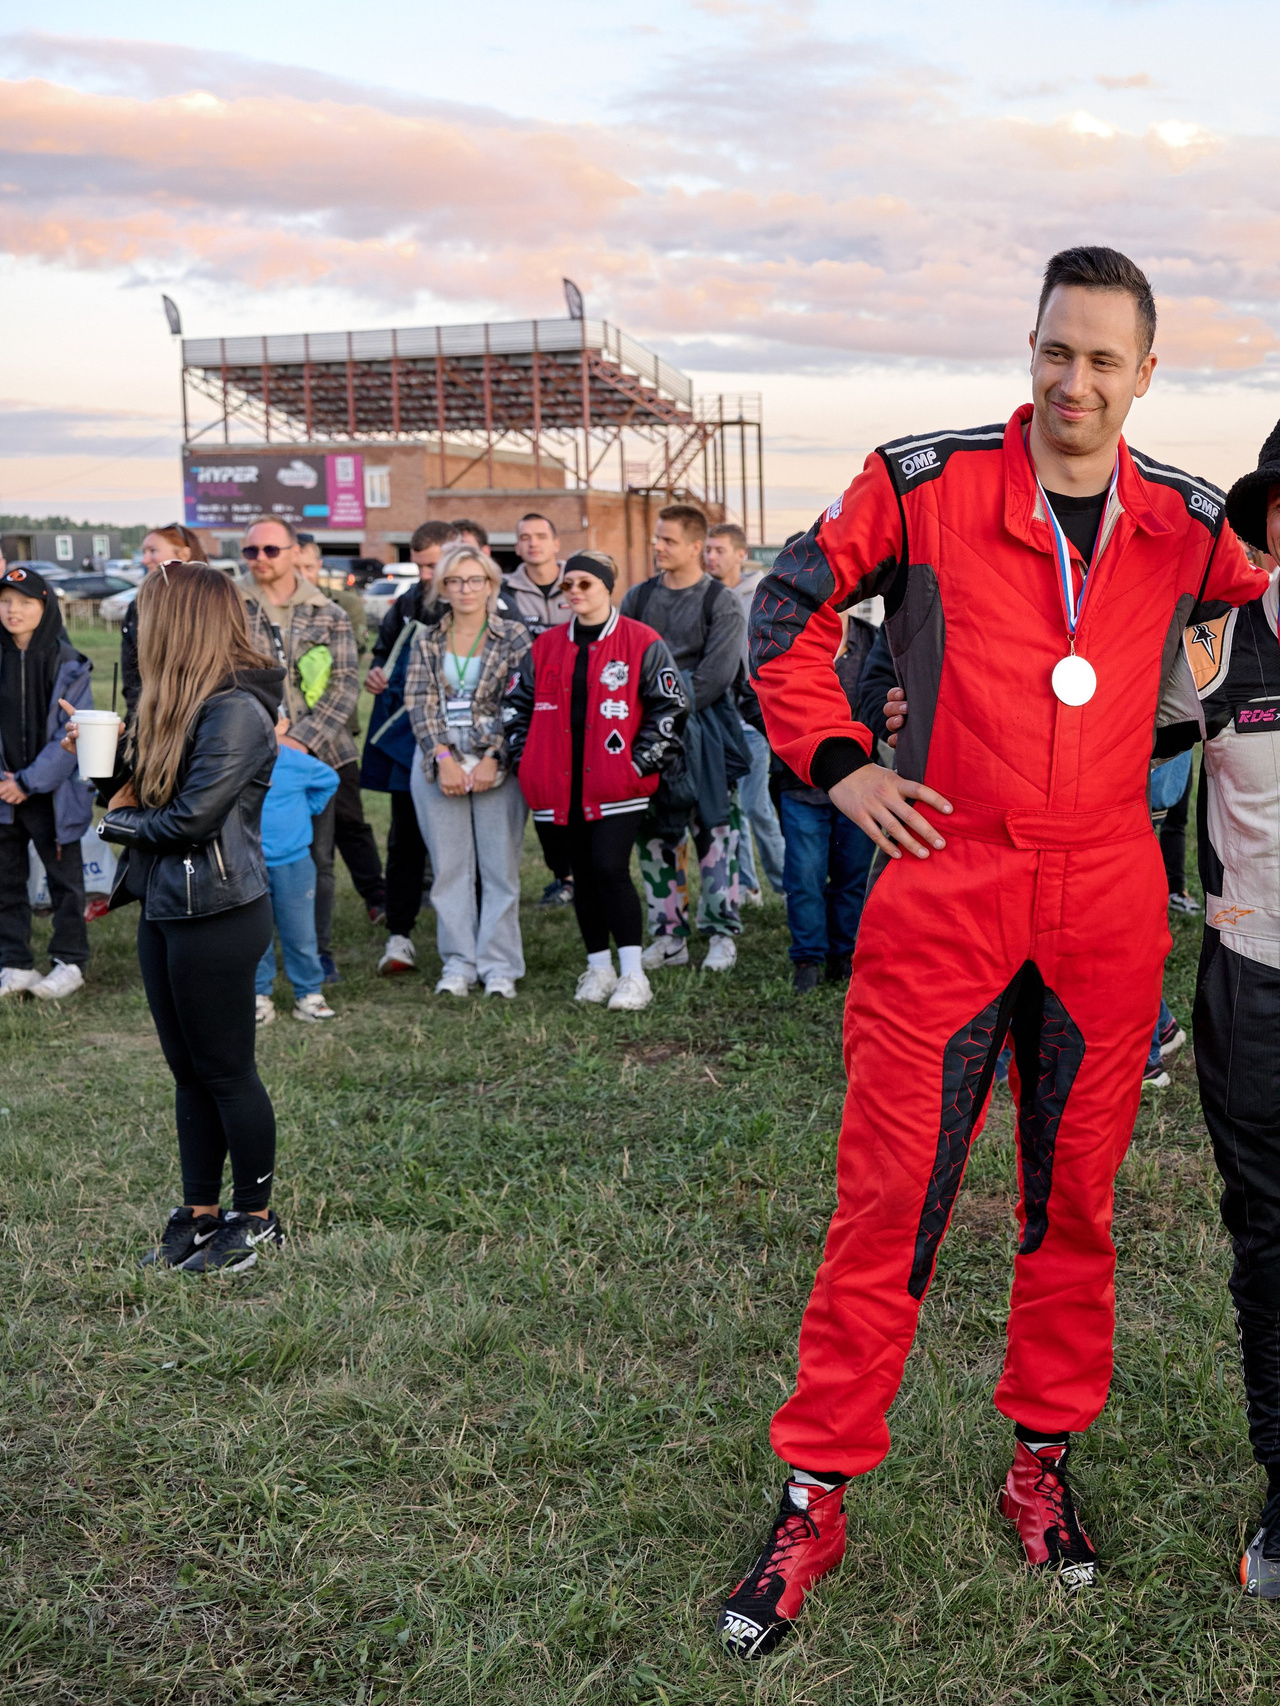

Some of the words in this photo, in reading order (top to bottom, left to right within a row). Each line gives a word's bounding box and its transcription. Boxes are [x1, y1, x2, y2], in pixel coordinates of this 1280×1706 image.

[901, 450, 937, 475] OMP
[197, 466, 259, 483] HYPER
[1190, 494, 1219, 518] OMP
[1238, 707, 1278, 724] RDS
